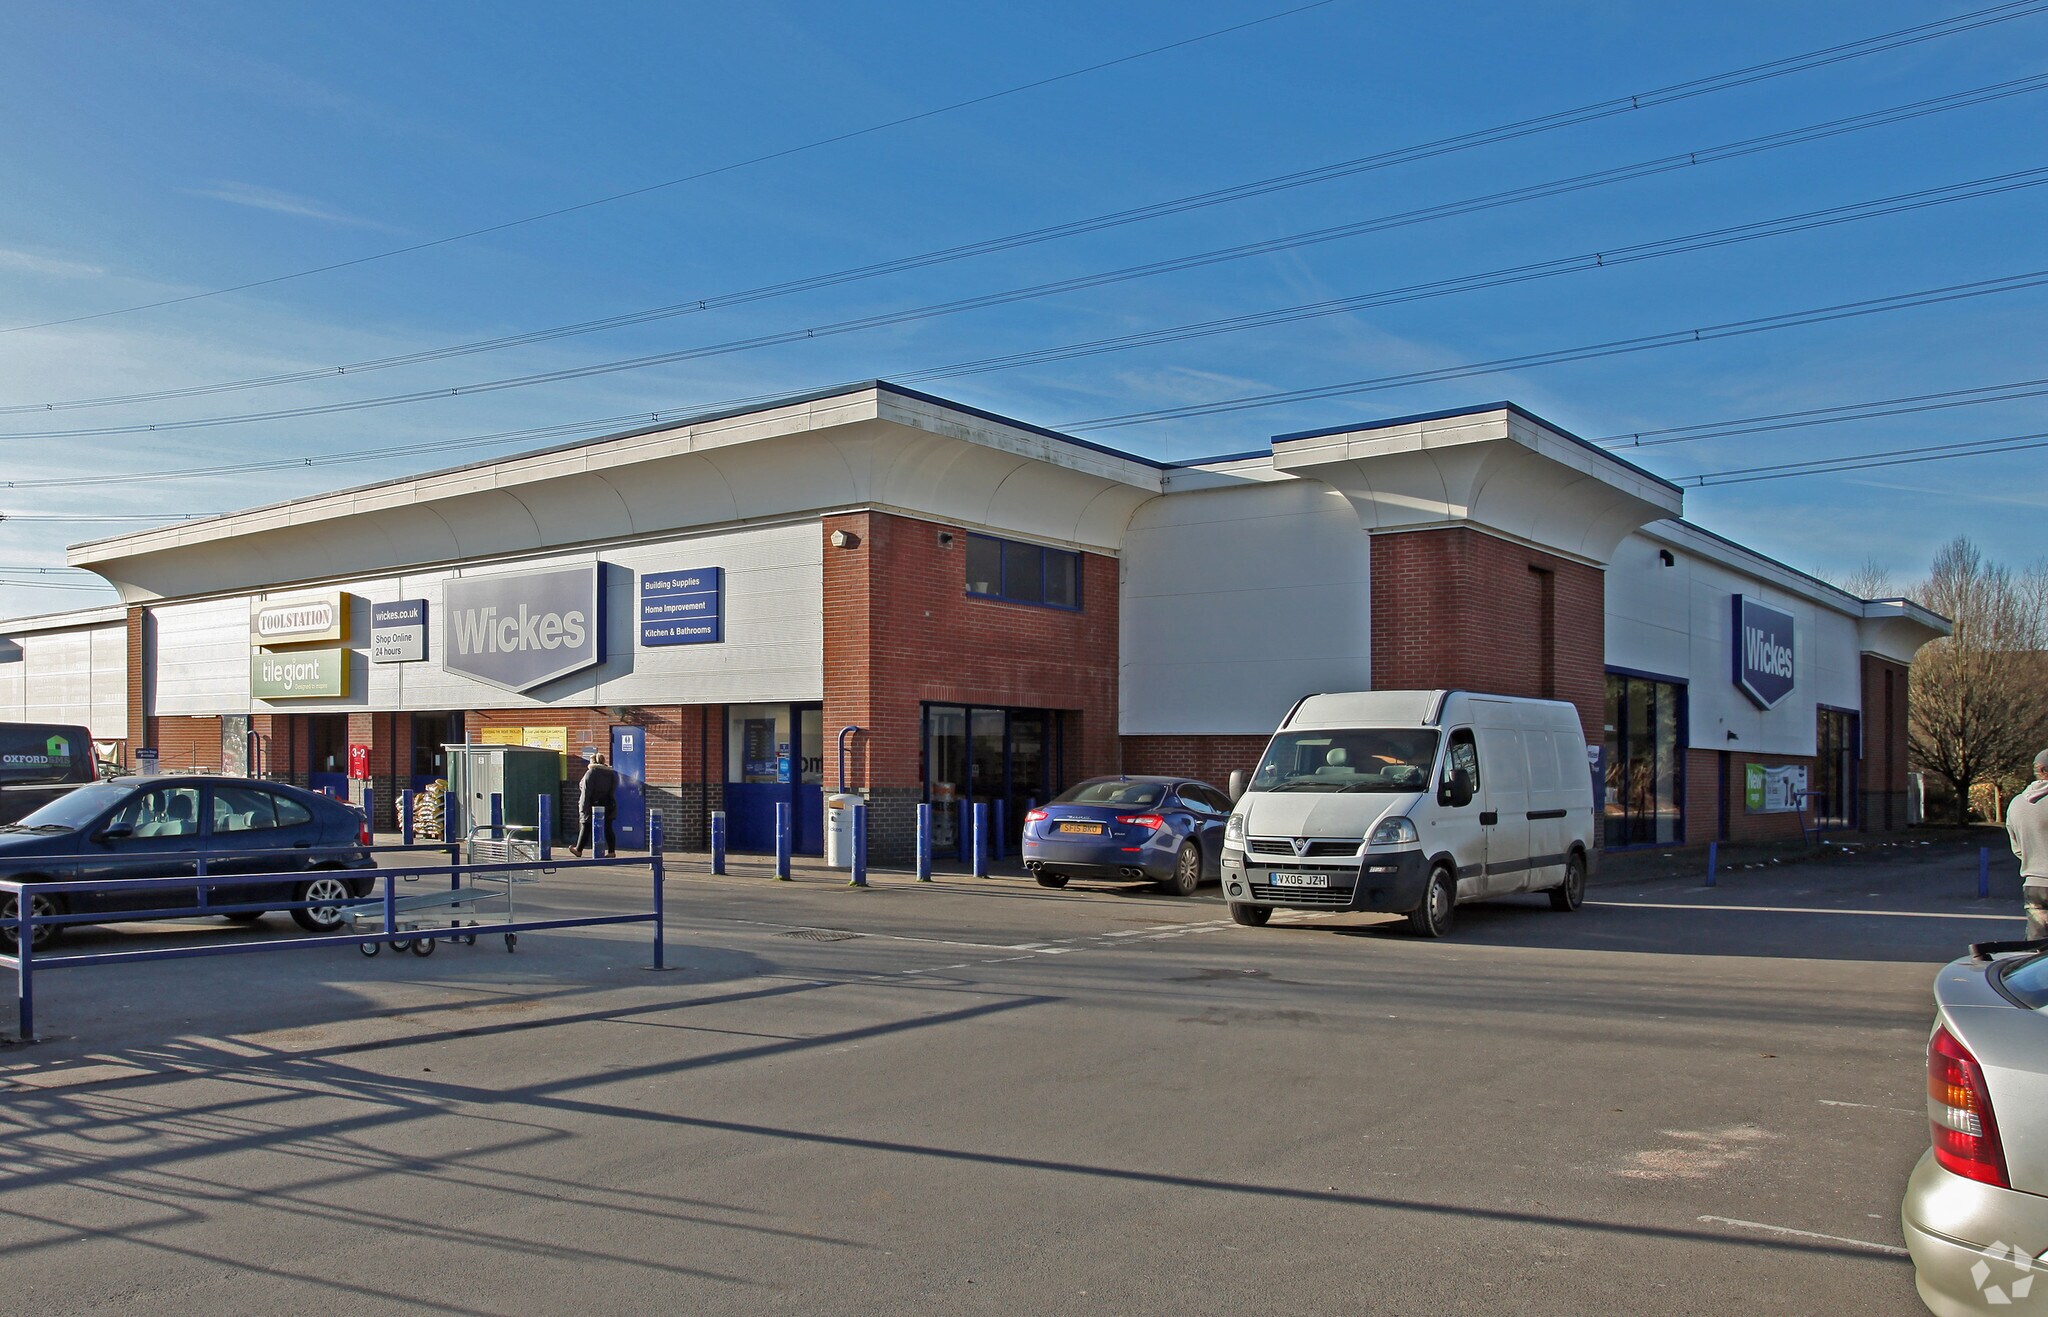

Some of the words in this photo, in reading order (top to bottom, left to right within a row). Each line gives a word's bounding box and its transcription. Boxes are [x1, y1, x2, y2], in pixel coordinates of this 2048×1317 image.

[645, 581, 671, 589] Building
[672, 578, 700, 588] Supplies
[645, 605, 663, 613] Home
[664, 601, 706, 613] Improvement
[261, 609, 330, 630] TOOLSTATION
[375, 607, 419, 621] wickes.co.uk
[453, 604, 585, 654] Wickes
[645, 629, 668, 637] Kitchen
[670, 627, 675, 636] &
[676, 626, 712, 636] Bathrooms
[375, 634, 391, 645] Shop
[392, 632, 413, 643] Online
[375, 647, 383, 656] 24
[384, 646, 402, 656] hours
[1746, 626, 1792, 678] Wickes
[1747, 769, 1763, 790] New
[1279, 875, 1302, 884] VX06
[1306, 876, 1325, 885] JZH
